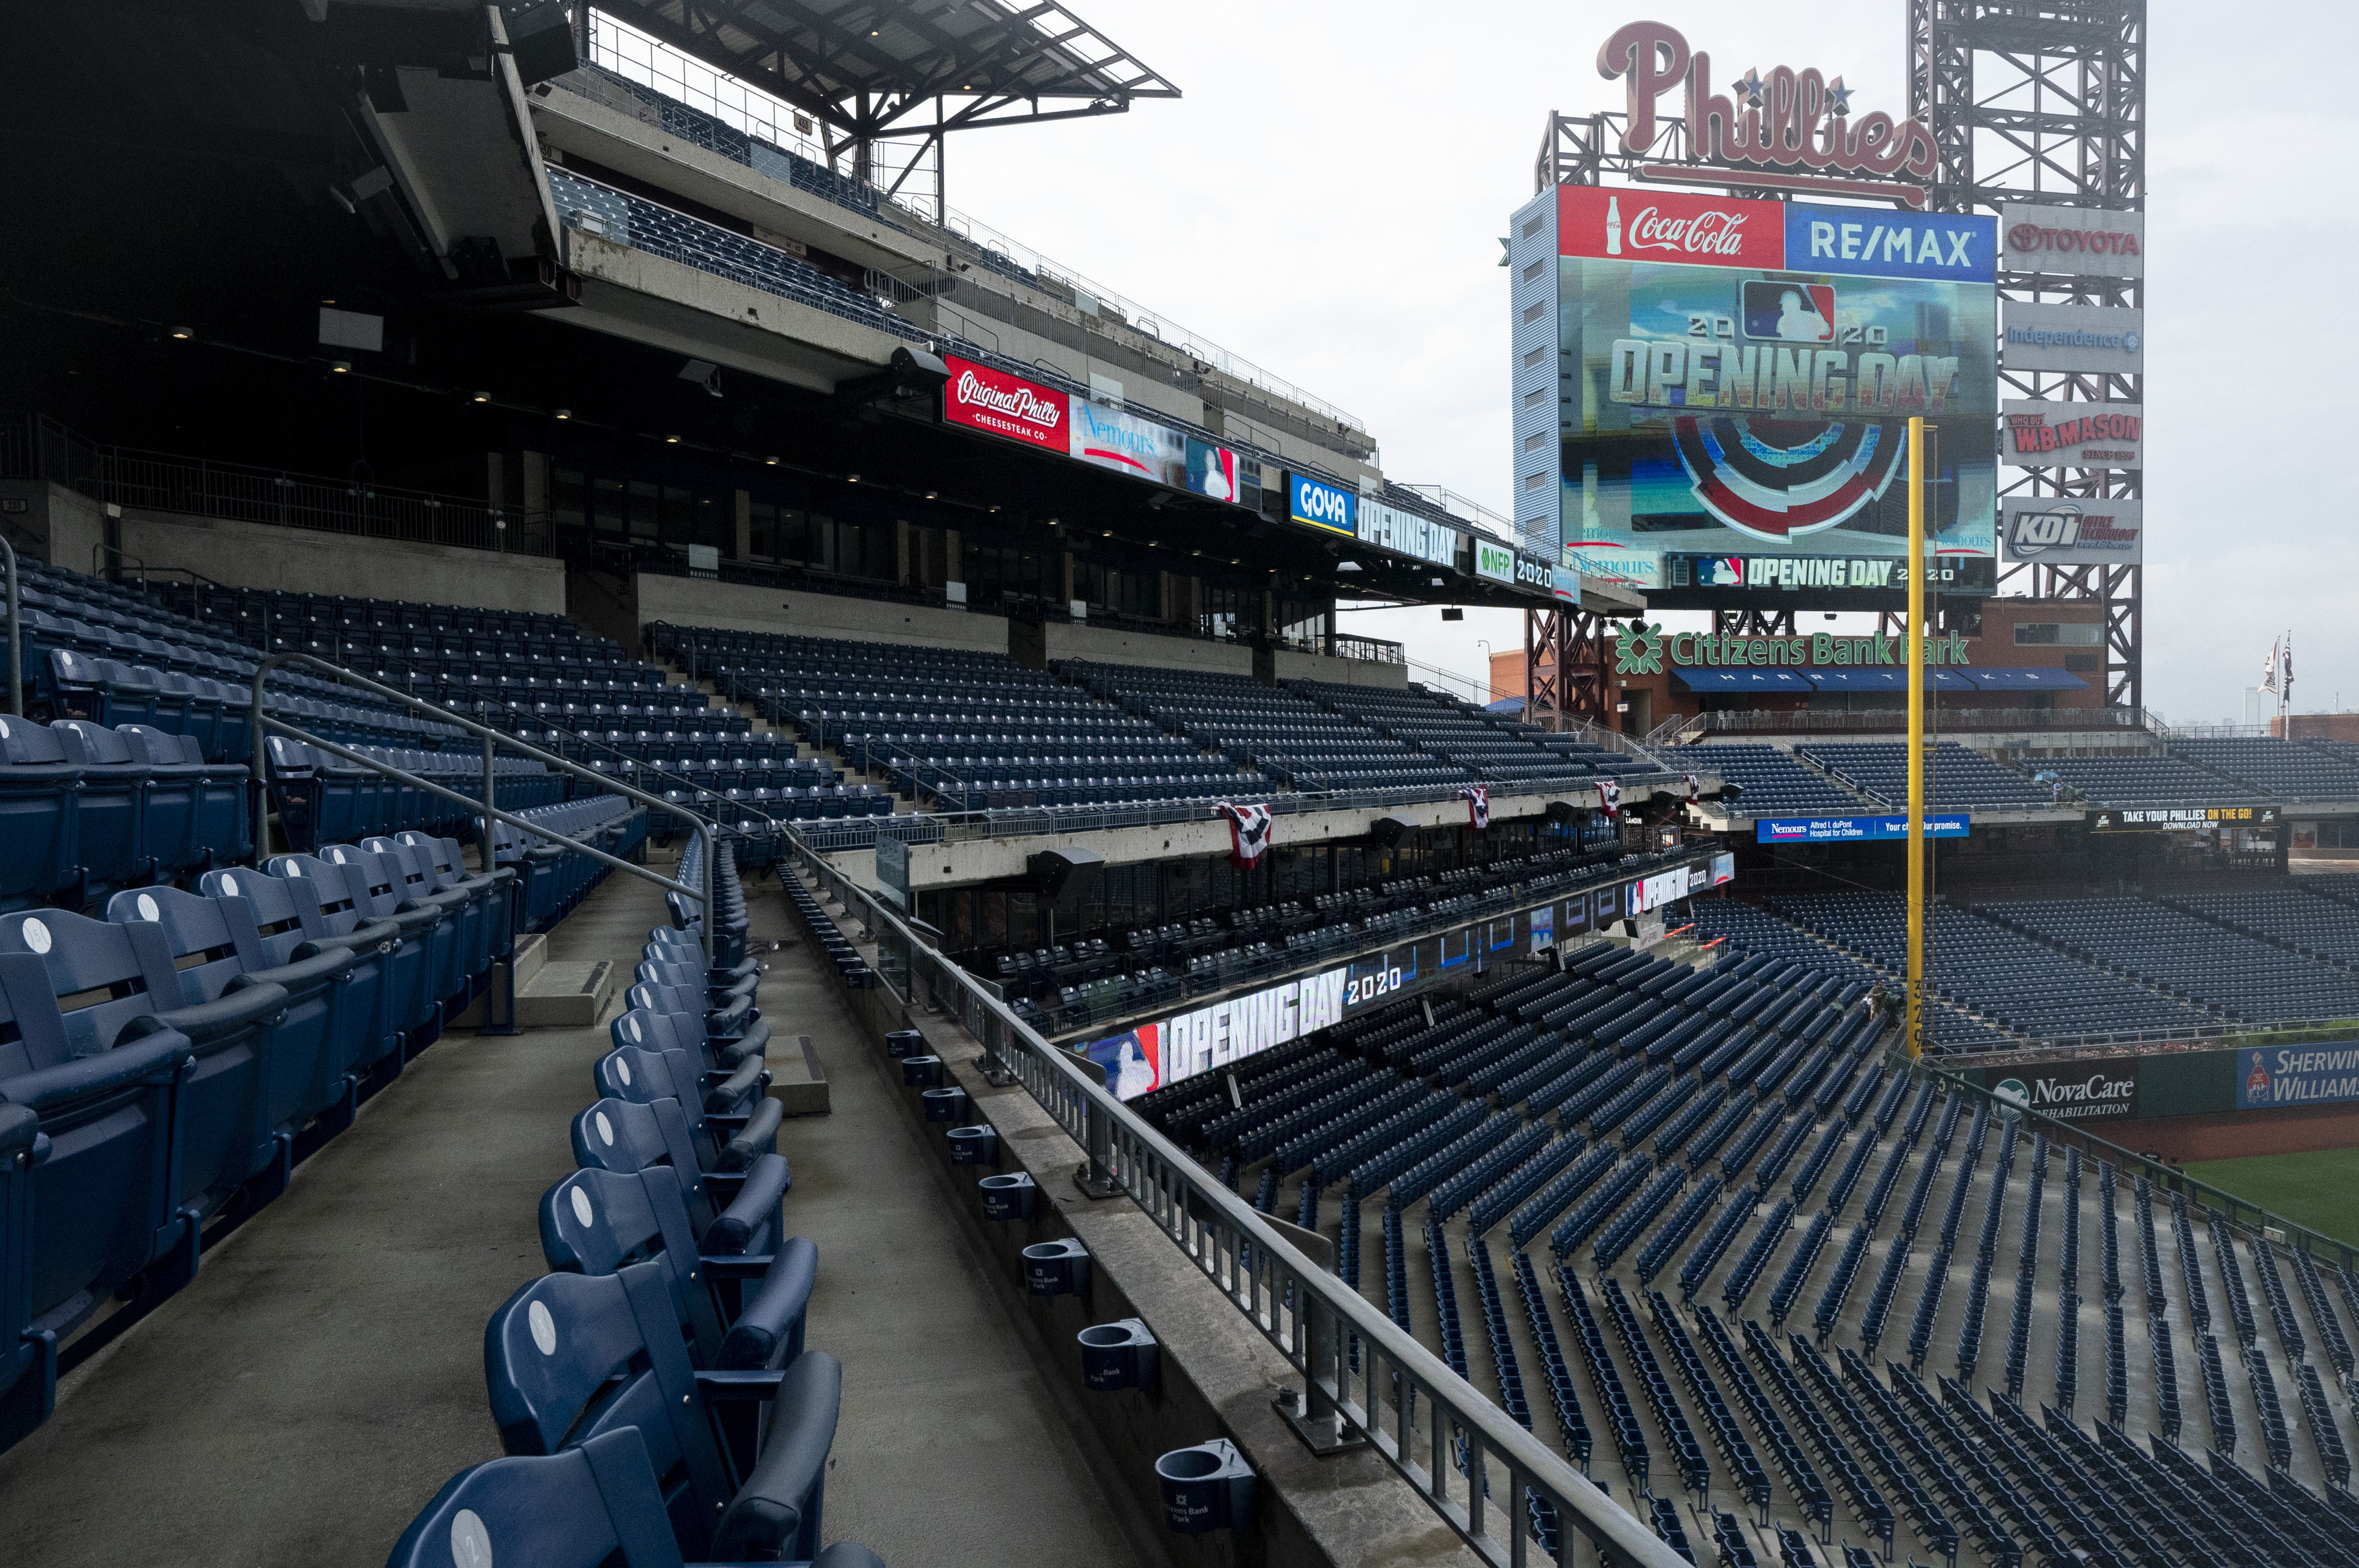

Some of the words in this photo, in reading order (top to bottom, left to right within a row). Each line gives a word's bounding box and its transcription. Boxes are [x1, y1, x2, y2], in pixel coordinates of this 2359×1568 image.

[1597, 20, 1939, 178] Phillies
[1629, 206, 1750, 255] Coca-Cola
[1811, 221, 1972, 268] RE/MAX
[2042, 227, 2140, 255] TOYOTA
[2008, 325, 2121, 349] Independence
[1609, 339, 1848, 410] OPENING
[1857, 351, 1960, 414] DAY
[958, 370, 1020, 414] Original
[1016, 387, 1061, 429] Philly
[2009, 416, 2029, 425] WHO
[2030, 416, 2045, 425] BUT
[2084, 449, 2115, 460] SINCE
[1300, 482, 1347, 524] GOYA
[1357, 497, 1428, 559] OPENING
[1428, 521, 1457, 567] DAY
[2013, 515, 2081, 544] KDI
[1490, 549, 1510, 576] NFP
[1516, 559, 1552, 588] 2020
[1748, 558, 1846, 586] OPENING
[1850, 561, 1893, 586] DAY
[1671, 631, 1805, 665] Citizens
[1813, 630, 1895, 665] Bank
[1771, 823, 1806, 834] Nemours
[1885, 823, 1901, 832] Your
[1934, 821, 1962, 832] promise.
[2122, 811, 2144, 822] TAKE
[2145, 810, 2168, 821] YOUR
[2170, 809, 2205, 821] PHILLIES
[2207, 809, 2219, 820] ON
[2221, 809, 2236, 819] THE
[2238, 809, 2252, 819] GO!
[2162, 821, 2201, 829] DOWNLOAD
[1810, 829, 1831, 838] Hospital
[1841, 828, 1863, 836] Children
[1643, 871, 1676, 911] OPENING
[1675, 867, 1689, 900] DAY
[1689, 870, 1706, 887] 2020
[1169, 982, 1298, 1083] OPENING
[1298, 968, 1346, 1037] DAY
[1347, 967, 1401, 1006] 2020
[2032, 1075, 2134, 1103] NovaCare
[1173, 1513, 1190, 1523] Park
[1188, 1505, 1208, 1515] Bank
